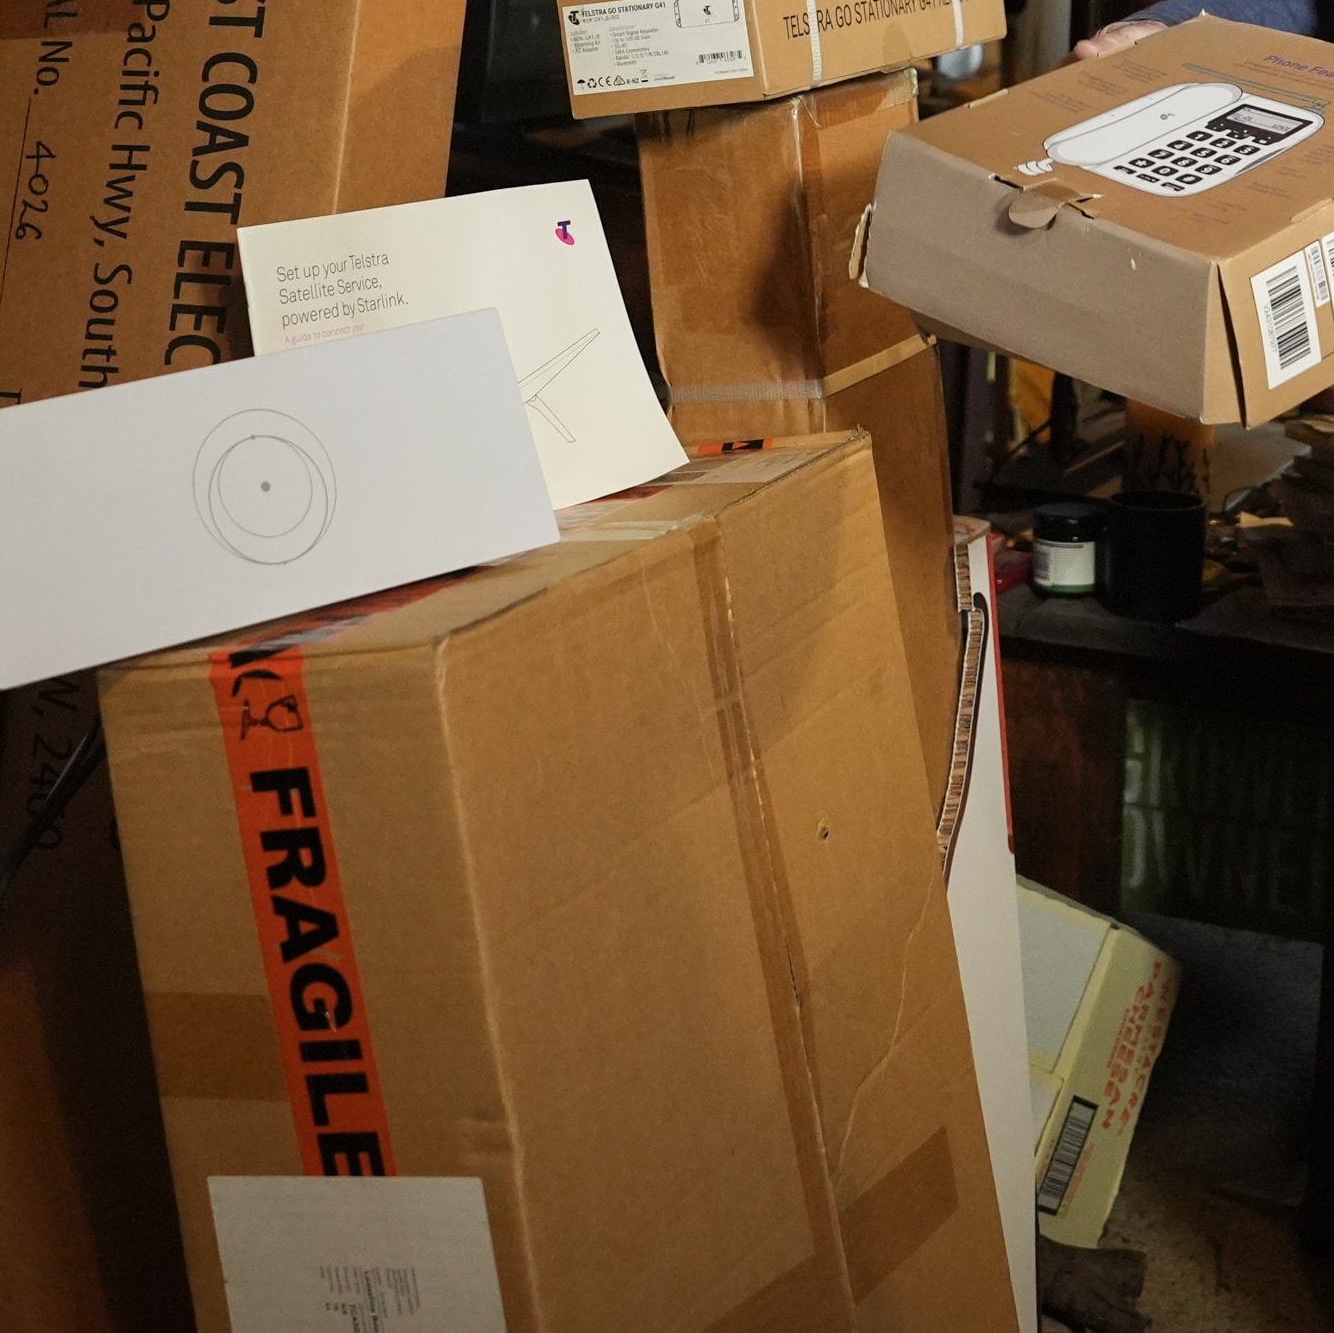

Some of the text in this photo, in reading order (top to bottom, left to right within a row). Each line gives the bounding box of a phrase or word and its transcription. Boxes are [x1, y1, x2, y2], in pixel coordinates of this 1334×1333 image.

[581, 1, 666, 18] TELSTRA GO STATIONARY G41
[783, 8, 835, 40] TELSRA
[835, 4, 853, 28] GO
[32, 40, 72, 96] No.
[1263, 53, 1309, 73] Phone
[183, 52, 258, 225] COAST
[14, 140, 57, 240] 4026
[89, 142, 152, 248] Hwy,
[276, 252, 390, 283] Set up your Telstra
[279, 275, 383, 305] Satellite Service,
[281, 290, 409, 330] powered by Starlink.
[78, 262, 134, 389] South
[284, 335, 291, 344] A
[291, 333, 312, 346] guide
[313, 331, 322, 341] to
[322, 326, 351, 339] connect
[248, 766, 386, 1177] FRAGILE
